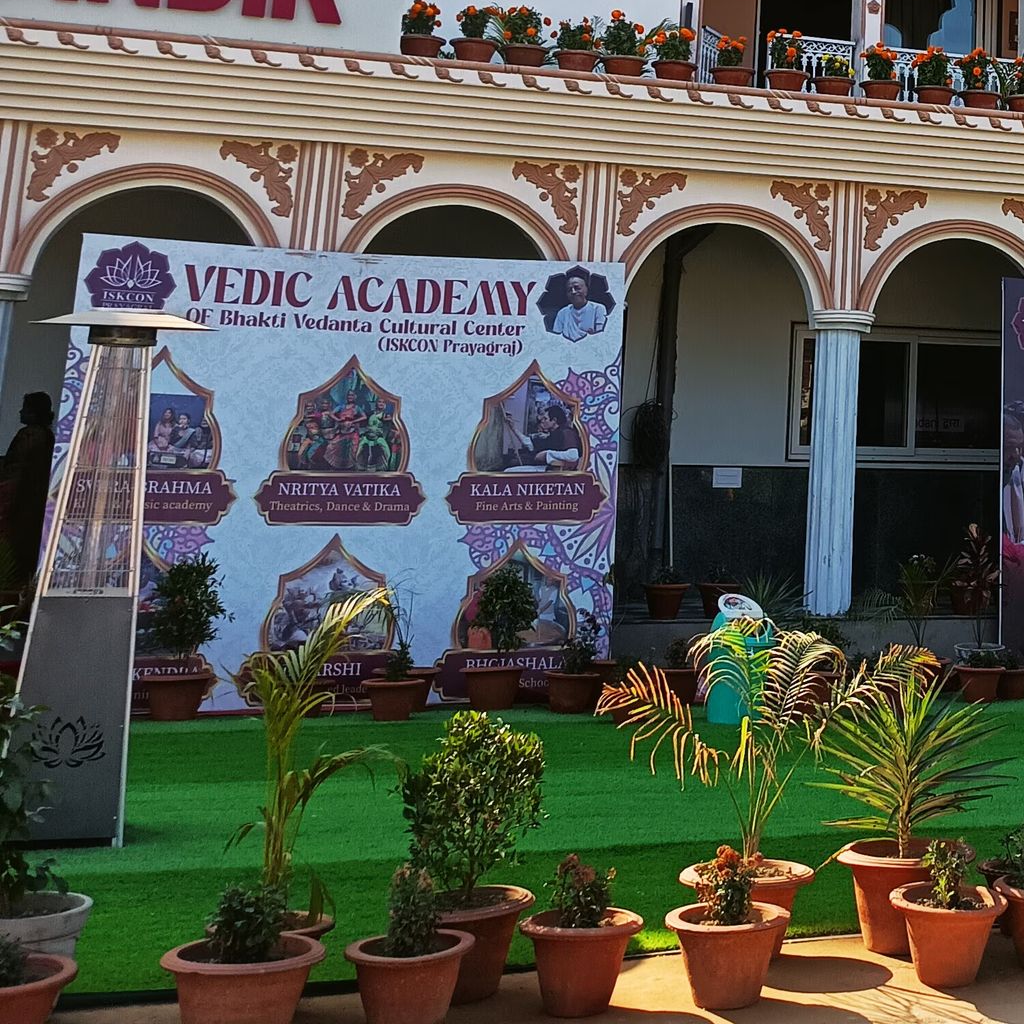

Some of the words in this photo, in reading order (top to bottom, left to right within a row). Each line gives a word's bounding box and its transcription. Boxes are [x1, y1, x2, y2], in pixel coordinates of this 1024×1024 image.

[103, 290, 155, 302] ISKCON
[184, 263, 313, 307] VEDIC
[326, 275, 537, 316] ACADEMY
[186, 307, 213, 325] OF
[220, 310, 286, 329] Bhakti
[293, 313, 372, 333] Vedanta
[379, 318, 457, 335] Cultural
[463, 321, 525, 337] Center
[377, 337, 438, 353] (ISKCON
[443, 339, 523, 357] Prayagraj)
[144, 480, 212, 495] RAHMA
[278, 482, 339, 496] NRITYA
[343, 483, 401, 497] VATIKA
[469, 483, 512, 497] KALA
[516, 482, 586, 496] NIKETAN
[163, 500, 214, 512] academy
[269, 500, 323, 513] Theatrics,
[326, 501, 360, 512] Dance
[362, 502, 371, 512] &
[374, 501, 410, 512] Drama
[475, 500, 499, 512] Fine
[501, 500, 523, 511] Arts
[524, 501, 533, 511] &
[535, 500, 579, 513] Painting
[518, 678, 550, 688] Schoo
